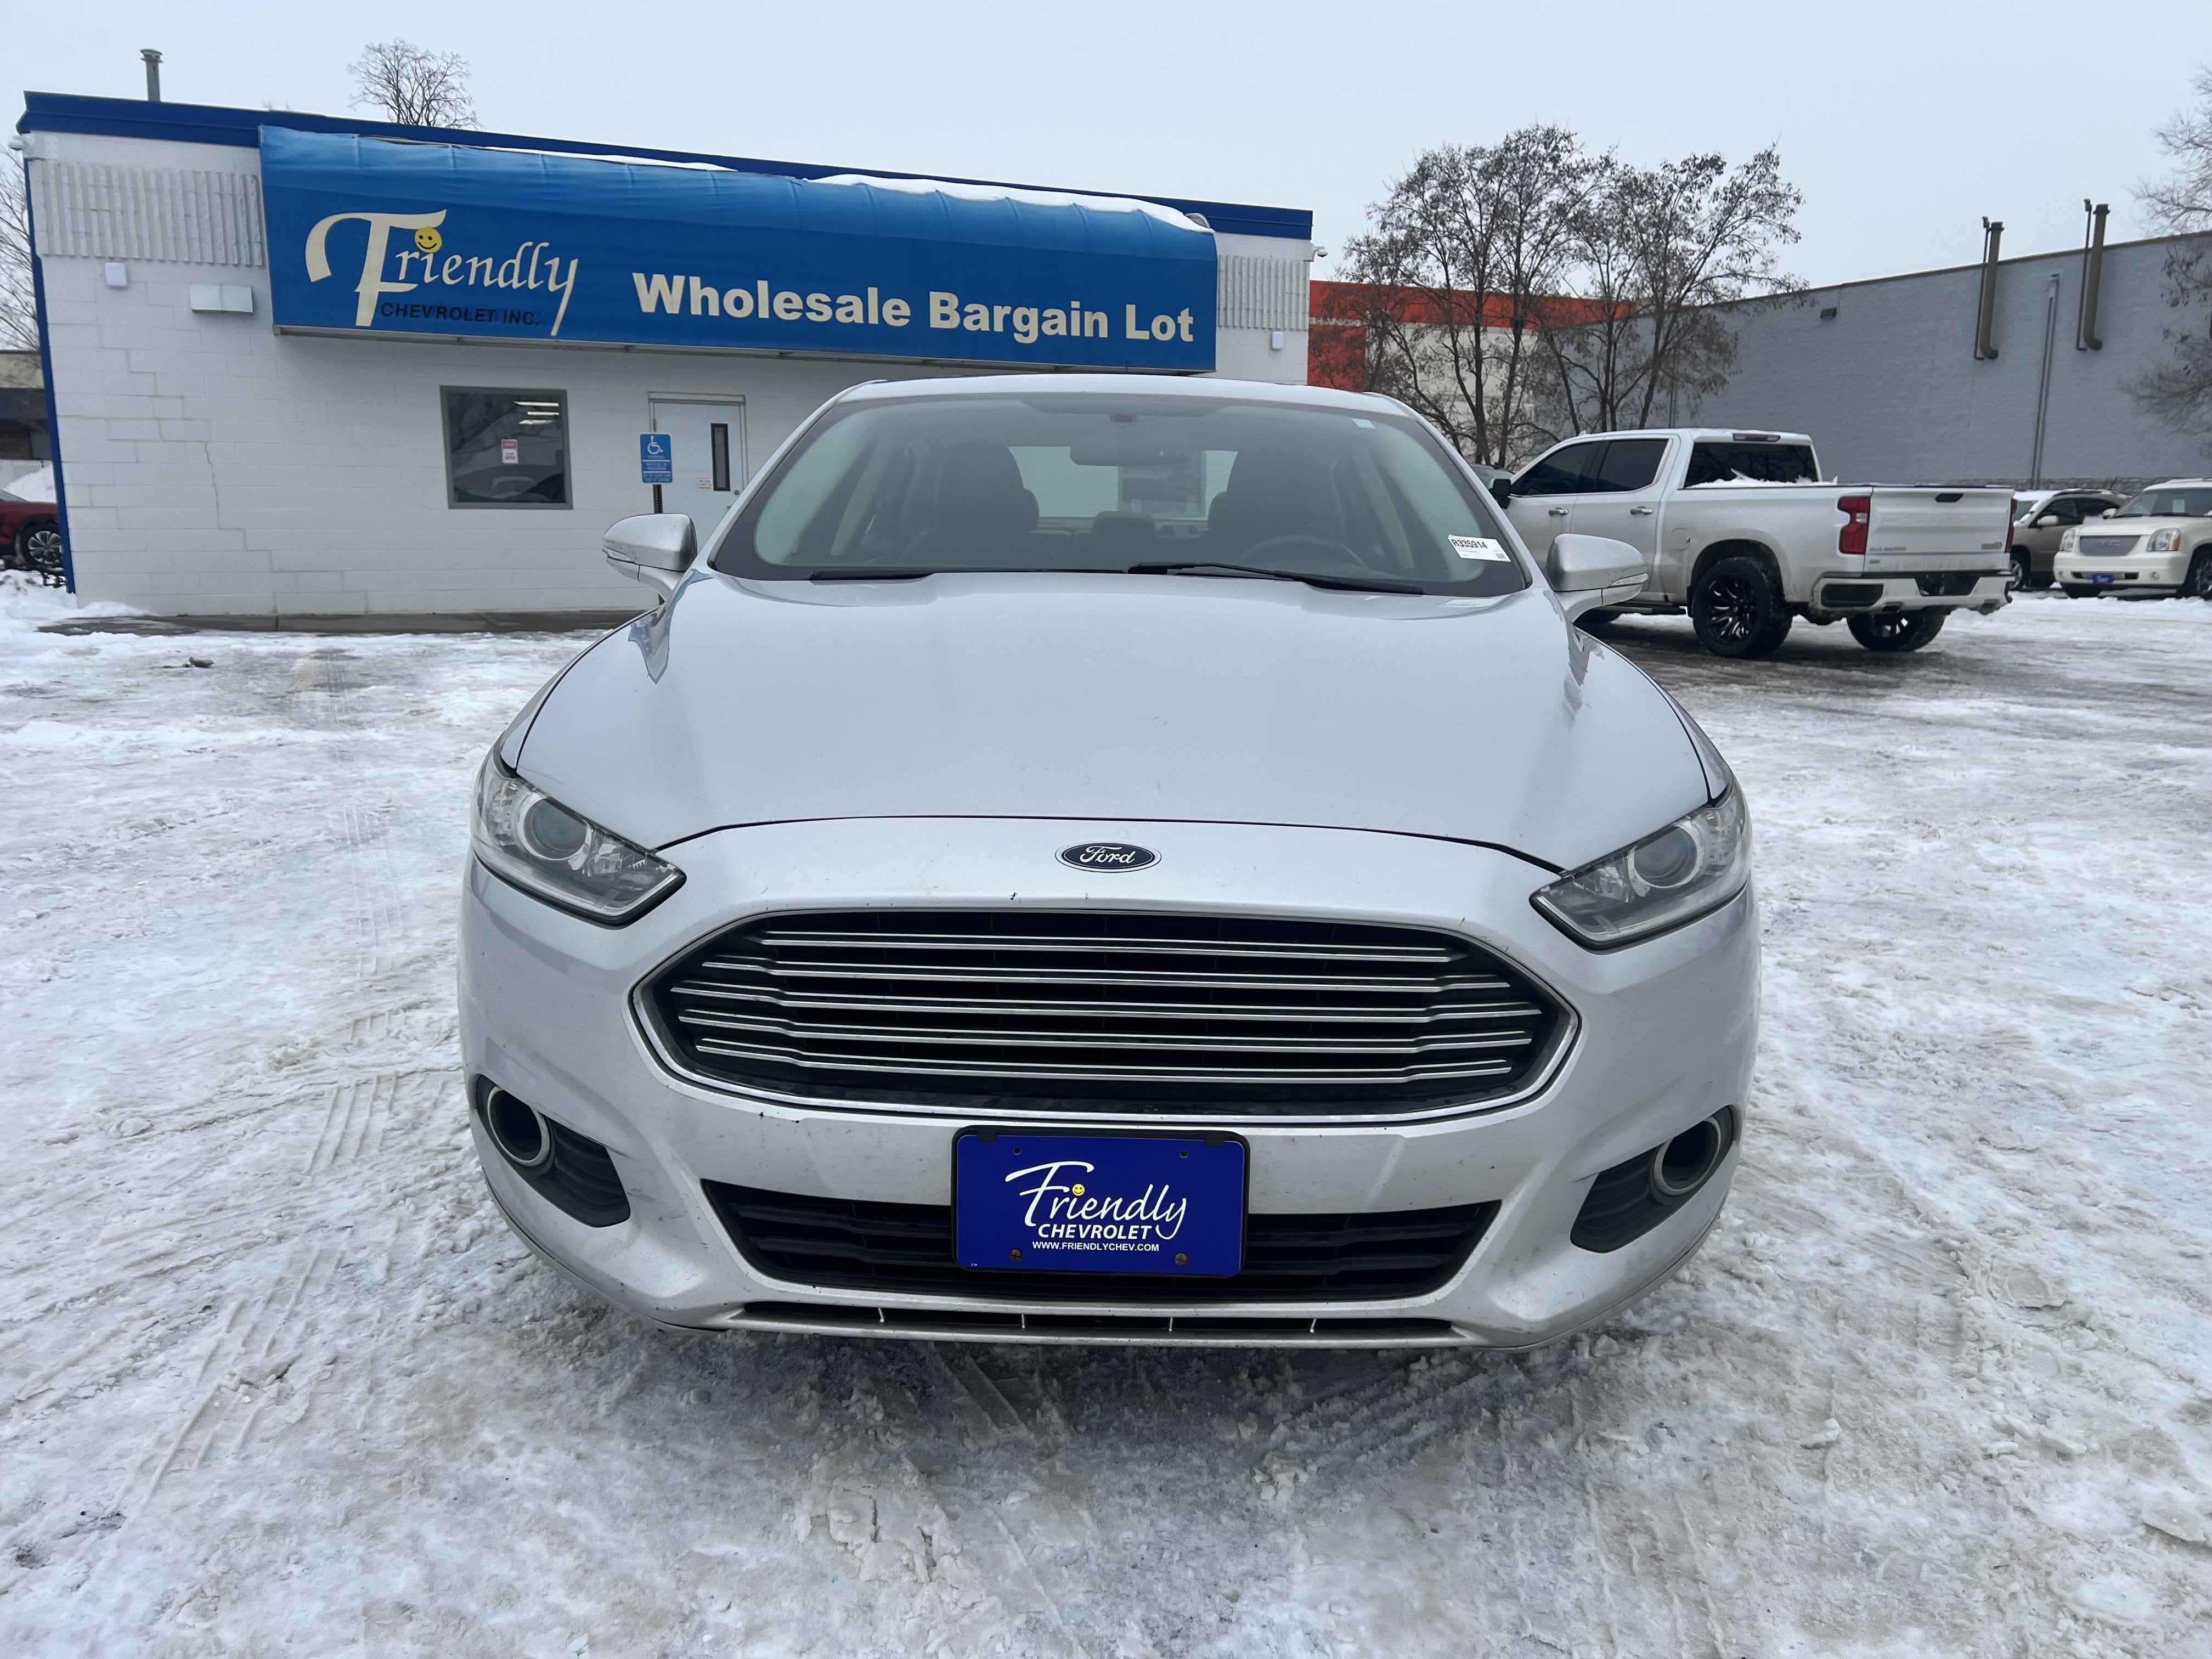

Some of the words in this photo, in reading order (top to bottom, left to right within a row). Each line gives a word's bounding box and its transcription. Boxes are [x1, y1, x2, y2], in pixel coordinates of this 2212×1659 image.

[305, 209, 578, 336] Friendly
[381, 302, 496, 323] CHEVROLET
[502, 309, 539, 325] INC.
[632, 273, 911, 326] Wholesale
[929, 291, 1108, 343] Bargain
[1125, 304, 1193, 342] Lot
[1080, 845, 1136, 864] Ford
[1005, 1161, 1187, 1240] Friendly
[1038, 1223, 1152, 1240] CHEVROLET
[1032, 1241, 1159, 1252] WWW.FRIENDLYCHEV.COM
